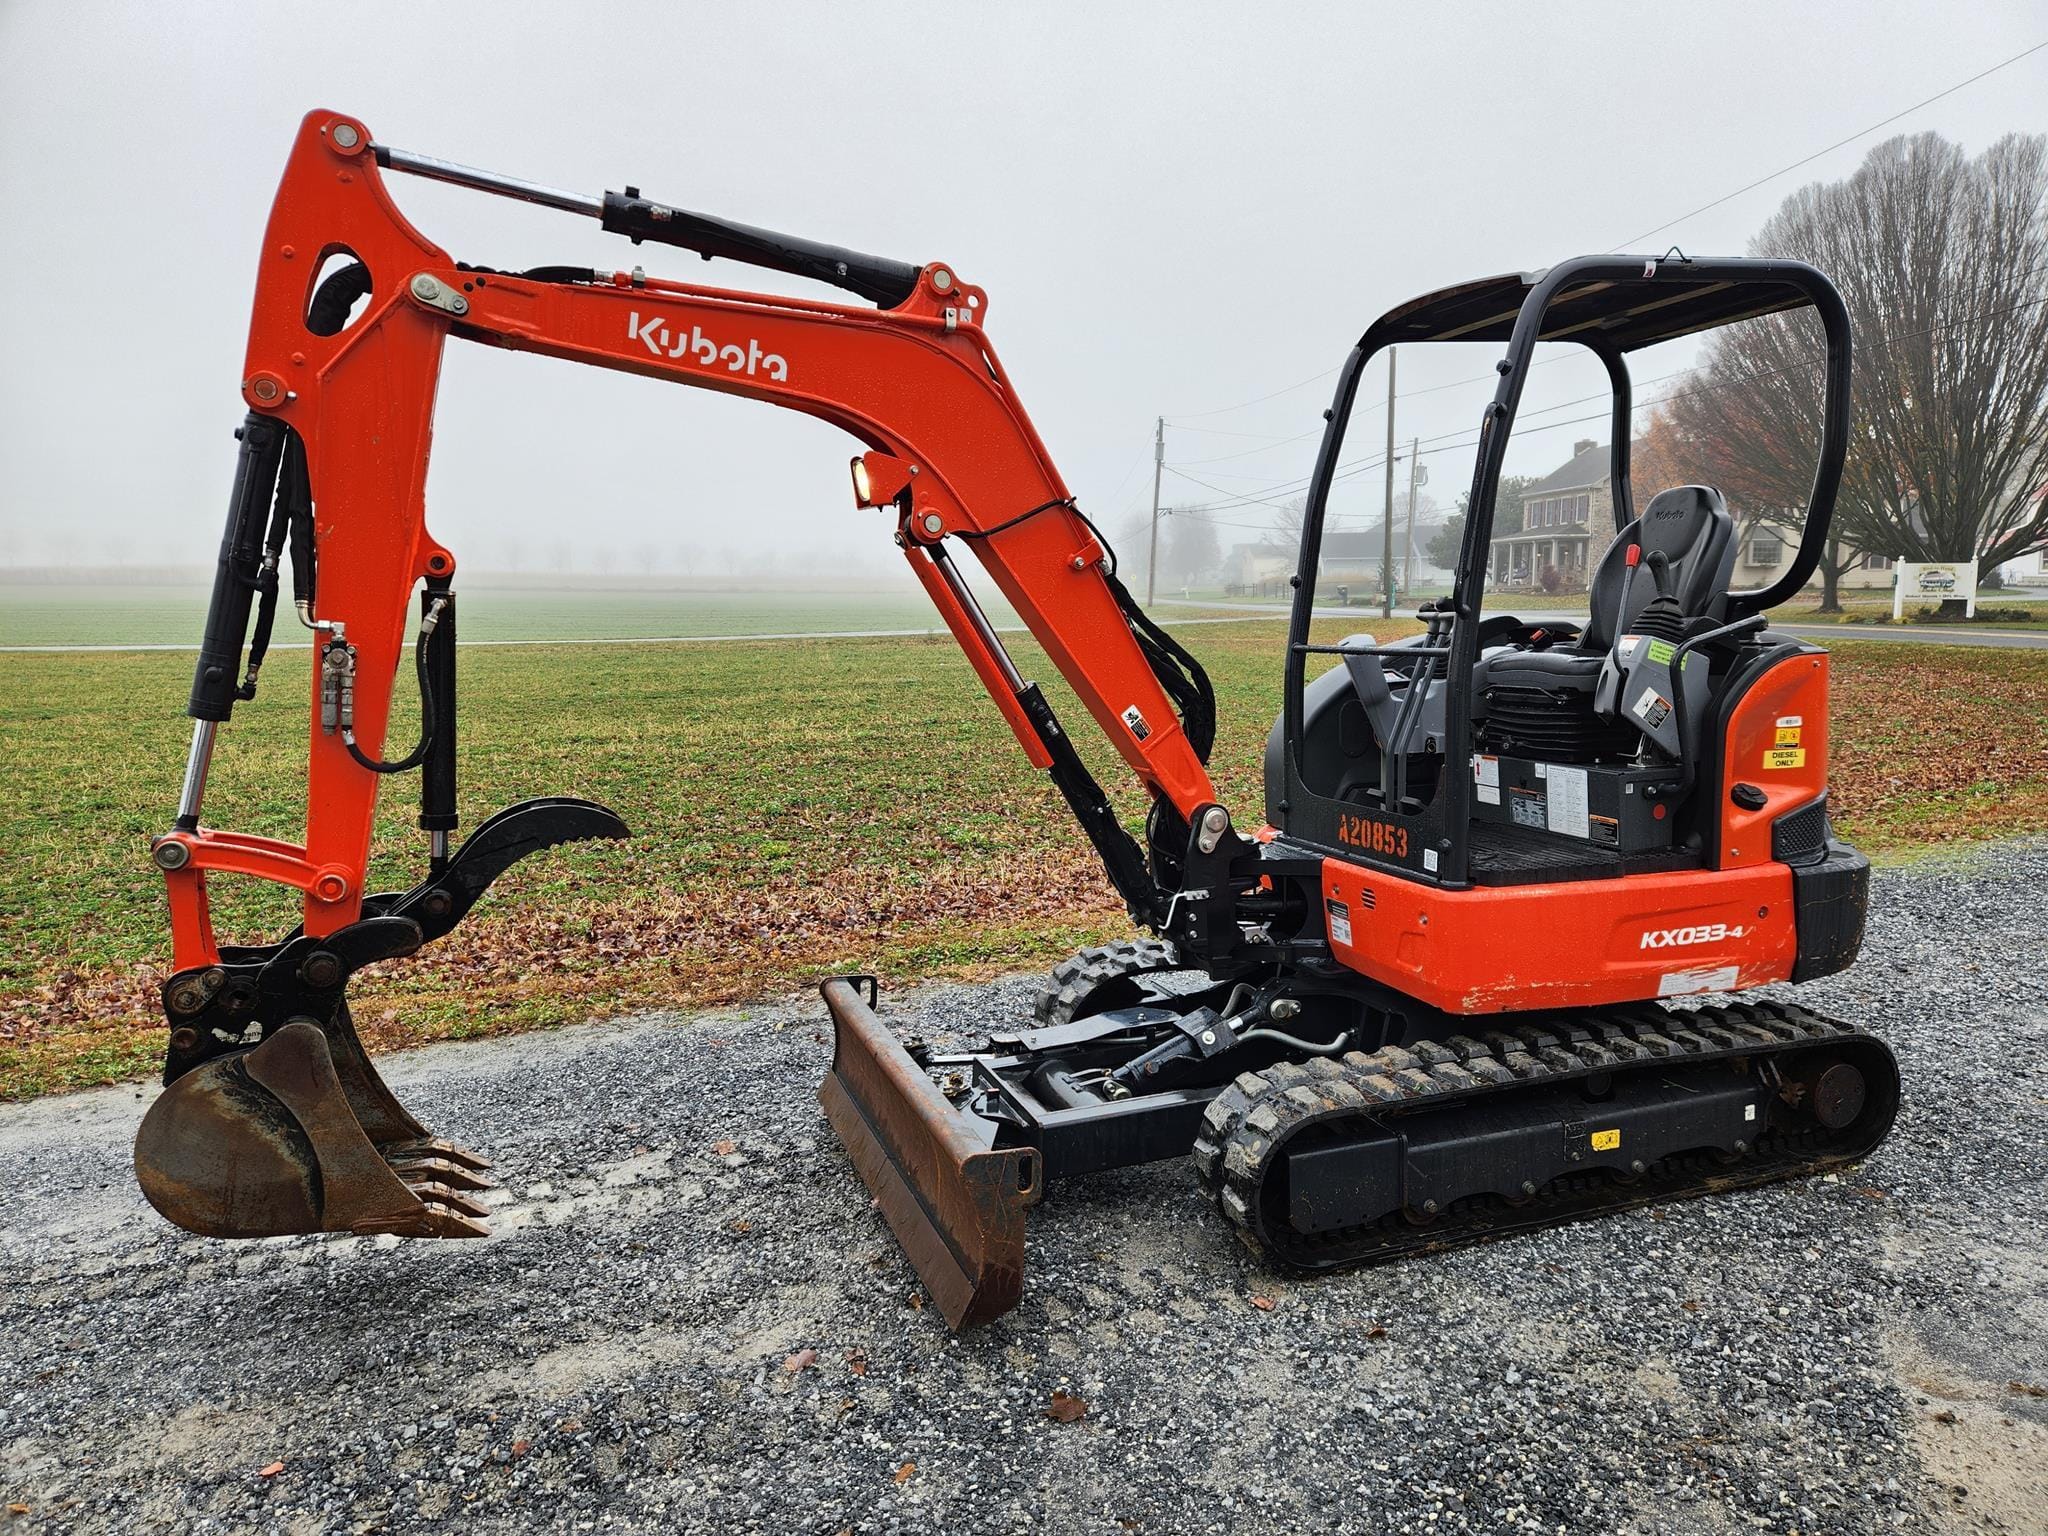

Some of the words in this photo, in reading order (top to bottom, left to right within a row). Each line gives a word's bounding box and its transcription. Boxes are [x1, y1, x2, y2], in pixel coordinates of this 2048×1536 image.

[628, 311, 788, 382] Kubota
[1772, 751, 1798, 759] DIESEL
[1775, 759, 1795, 767] ONLY
[1338, 813, 1408, 858] A20853
[1640, 923, 1744, 950] KX033-4
